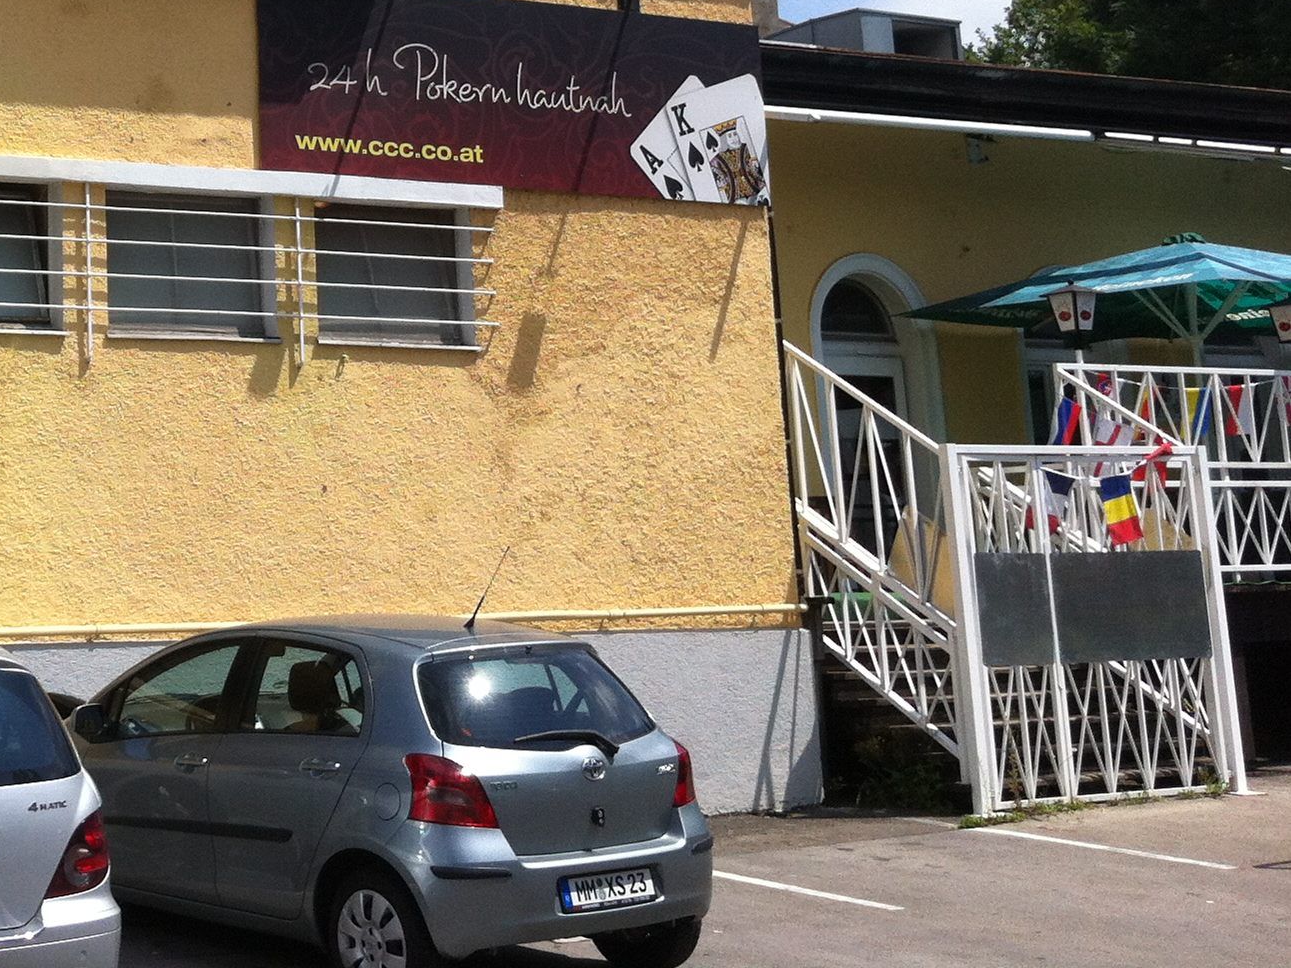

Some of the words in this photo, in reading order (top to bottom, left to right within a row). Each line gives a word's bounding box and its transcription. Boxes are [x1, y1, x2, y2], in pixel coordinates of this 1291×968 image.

[308, 61, 358, 94] 24
[365, 46, 388, 96] h
[392, 42, 512, 105] Pokern
[515, 61, 633, 118] hautnah
[671, 102, 695, 136] K
[294, 134, 485, 164] www.ccc.co.at
[639, 144, 664, 175] A
[574, 879, 598, 903] MM
